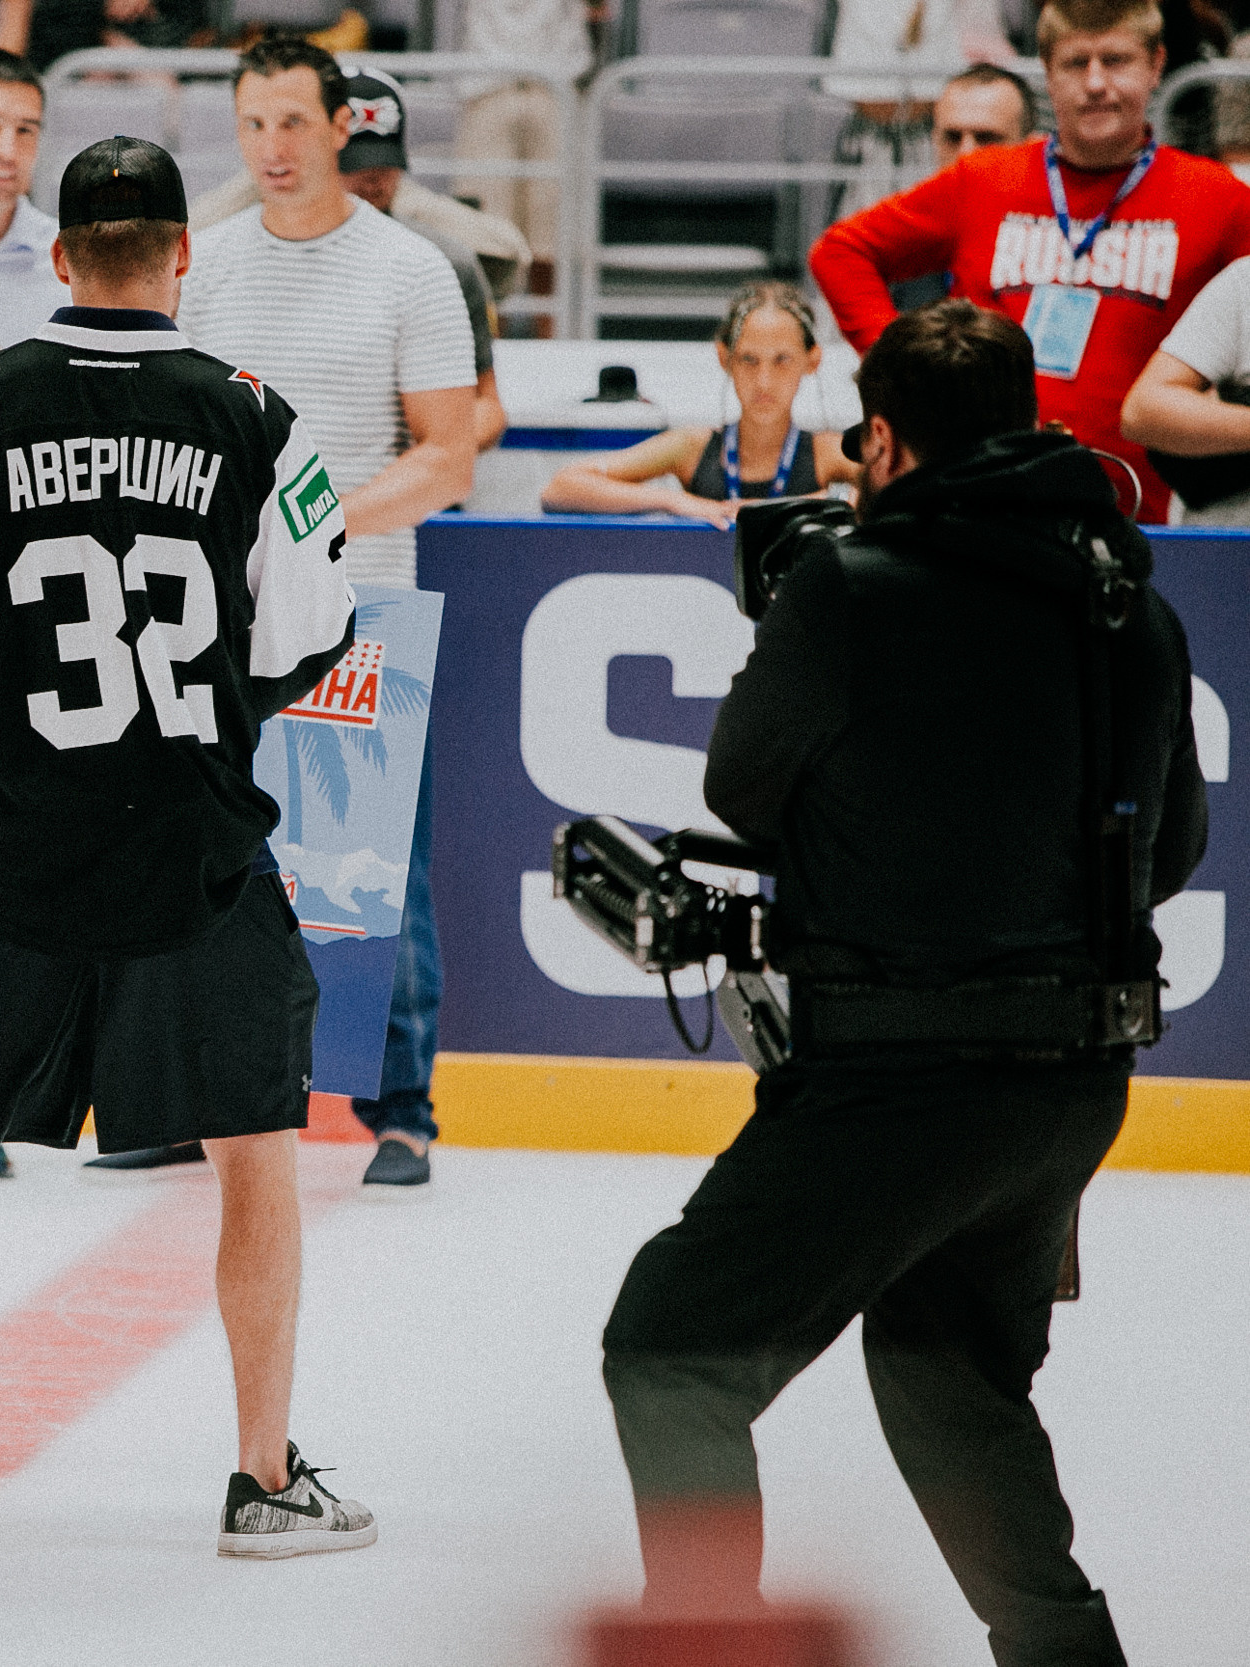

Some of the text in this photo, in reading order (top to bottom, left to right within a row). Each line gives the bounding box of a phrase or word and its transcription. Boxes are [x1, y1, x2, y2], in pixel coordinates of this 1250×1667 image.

[6, 436, 223, 515] АВЕРШИН
[305, 488, 336, 528] ЛИГА
[7, 533, 219, 751] 32
